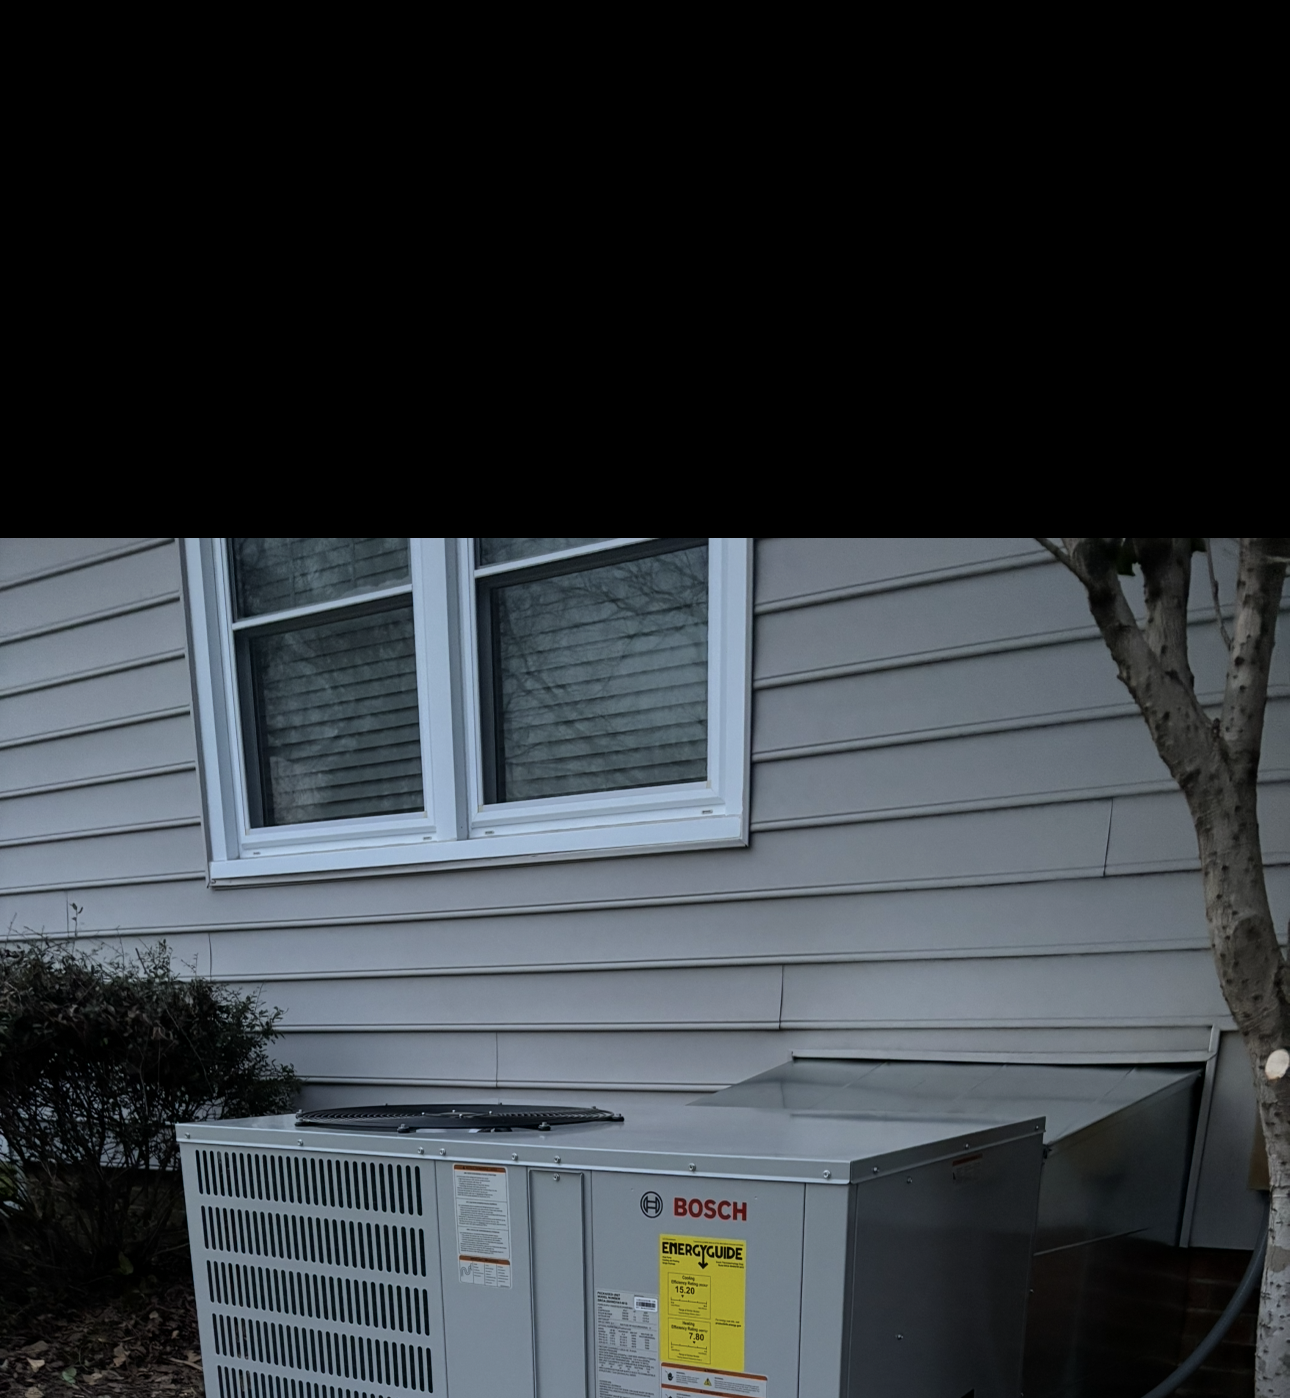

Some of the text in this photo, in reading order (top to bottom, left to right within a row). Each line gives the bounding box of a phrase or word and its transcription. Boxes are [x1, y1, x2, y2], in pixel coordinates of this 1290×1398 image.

[673, 1197, 747, 1221] BOSCH
[661, 1241, 743, 1261] ENERGYGUIDE
[675, 1286, 695, 1295] 15.20
[689, 1332, 705, 1341] 7.80
